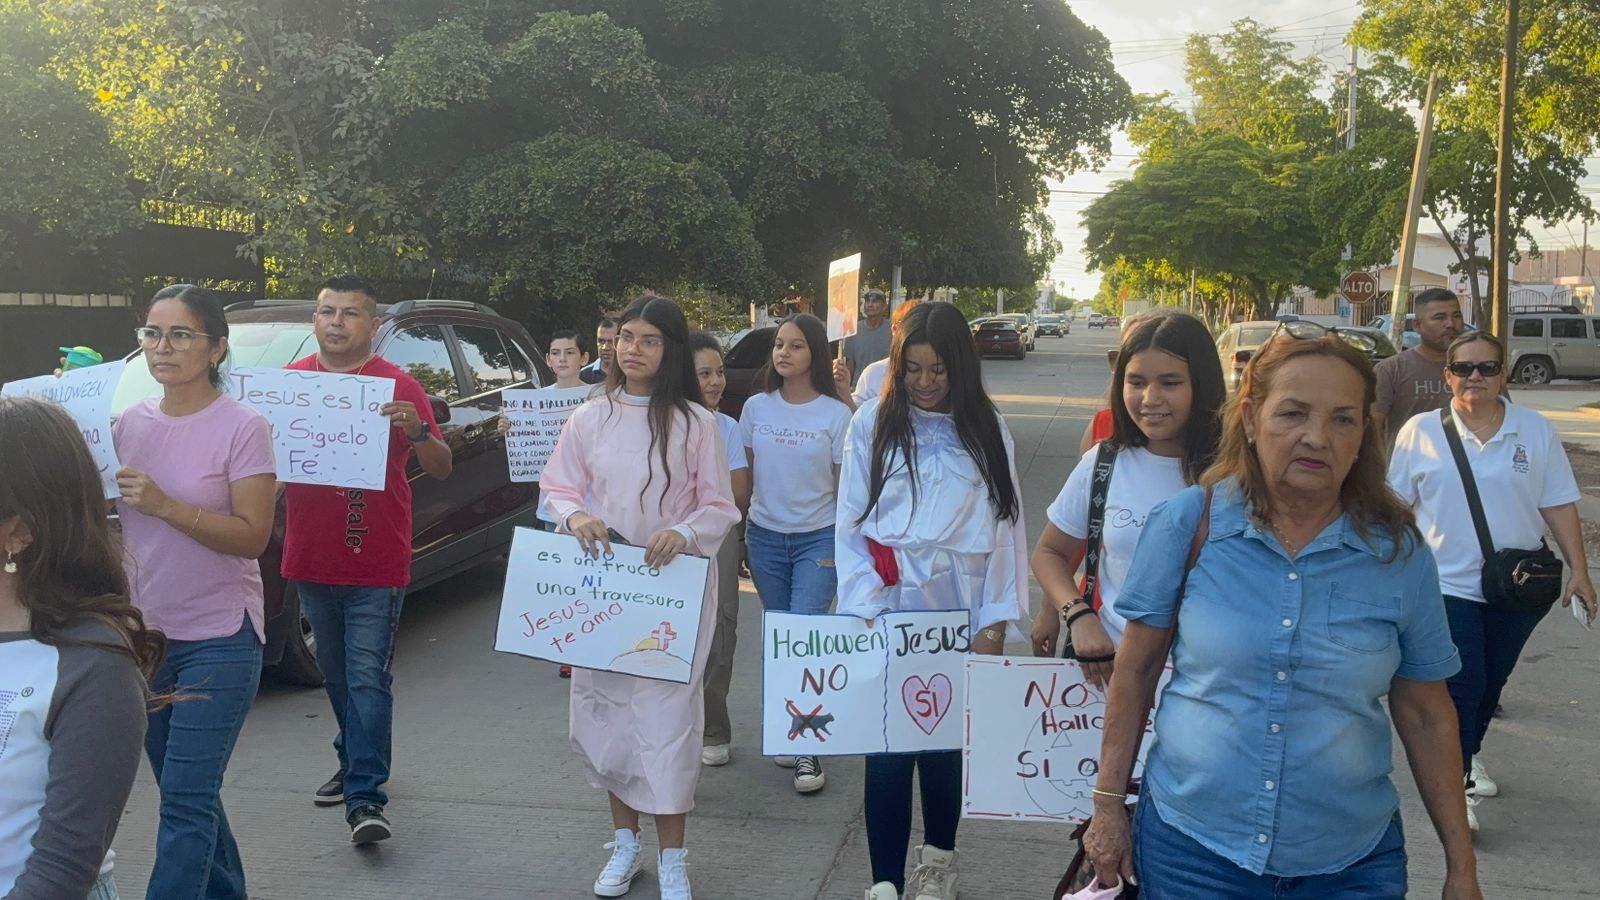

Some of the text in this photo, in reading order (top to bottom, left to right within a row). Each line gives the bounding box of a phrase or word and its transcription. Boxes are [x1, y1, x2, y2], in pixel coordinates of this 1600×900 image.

[1344, 281, 1373, 293] ALTO
[322, 394, 352, 409] es
[503, 400, 518, 408] NO
[522, 400, 535, 409] AL
[288, 418, 368, 448] Siguelo
[538, 551, 660, 577] es un truco
[588, 587, 684, 609] travesura
[520, 600, 589, 638] Jesus
[550, 602, 624, 653] te ama
[773, 628, 884, 659] Hallowen
[801, 664, 848, 696] NO
